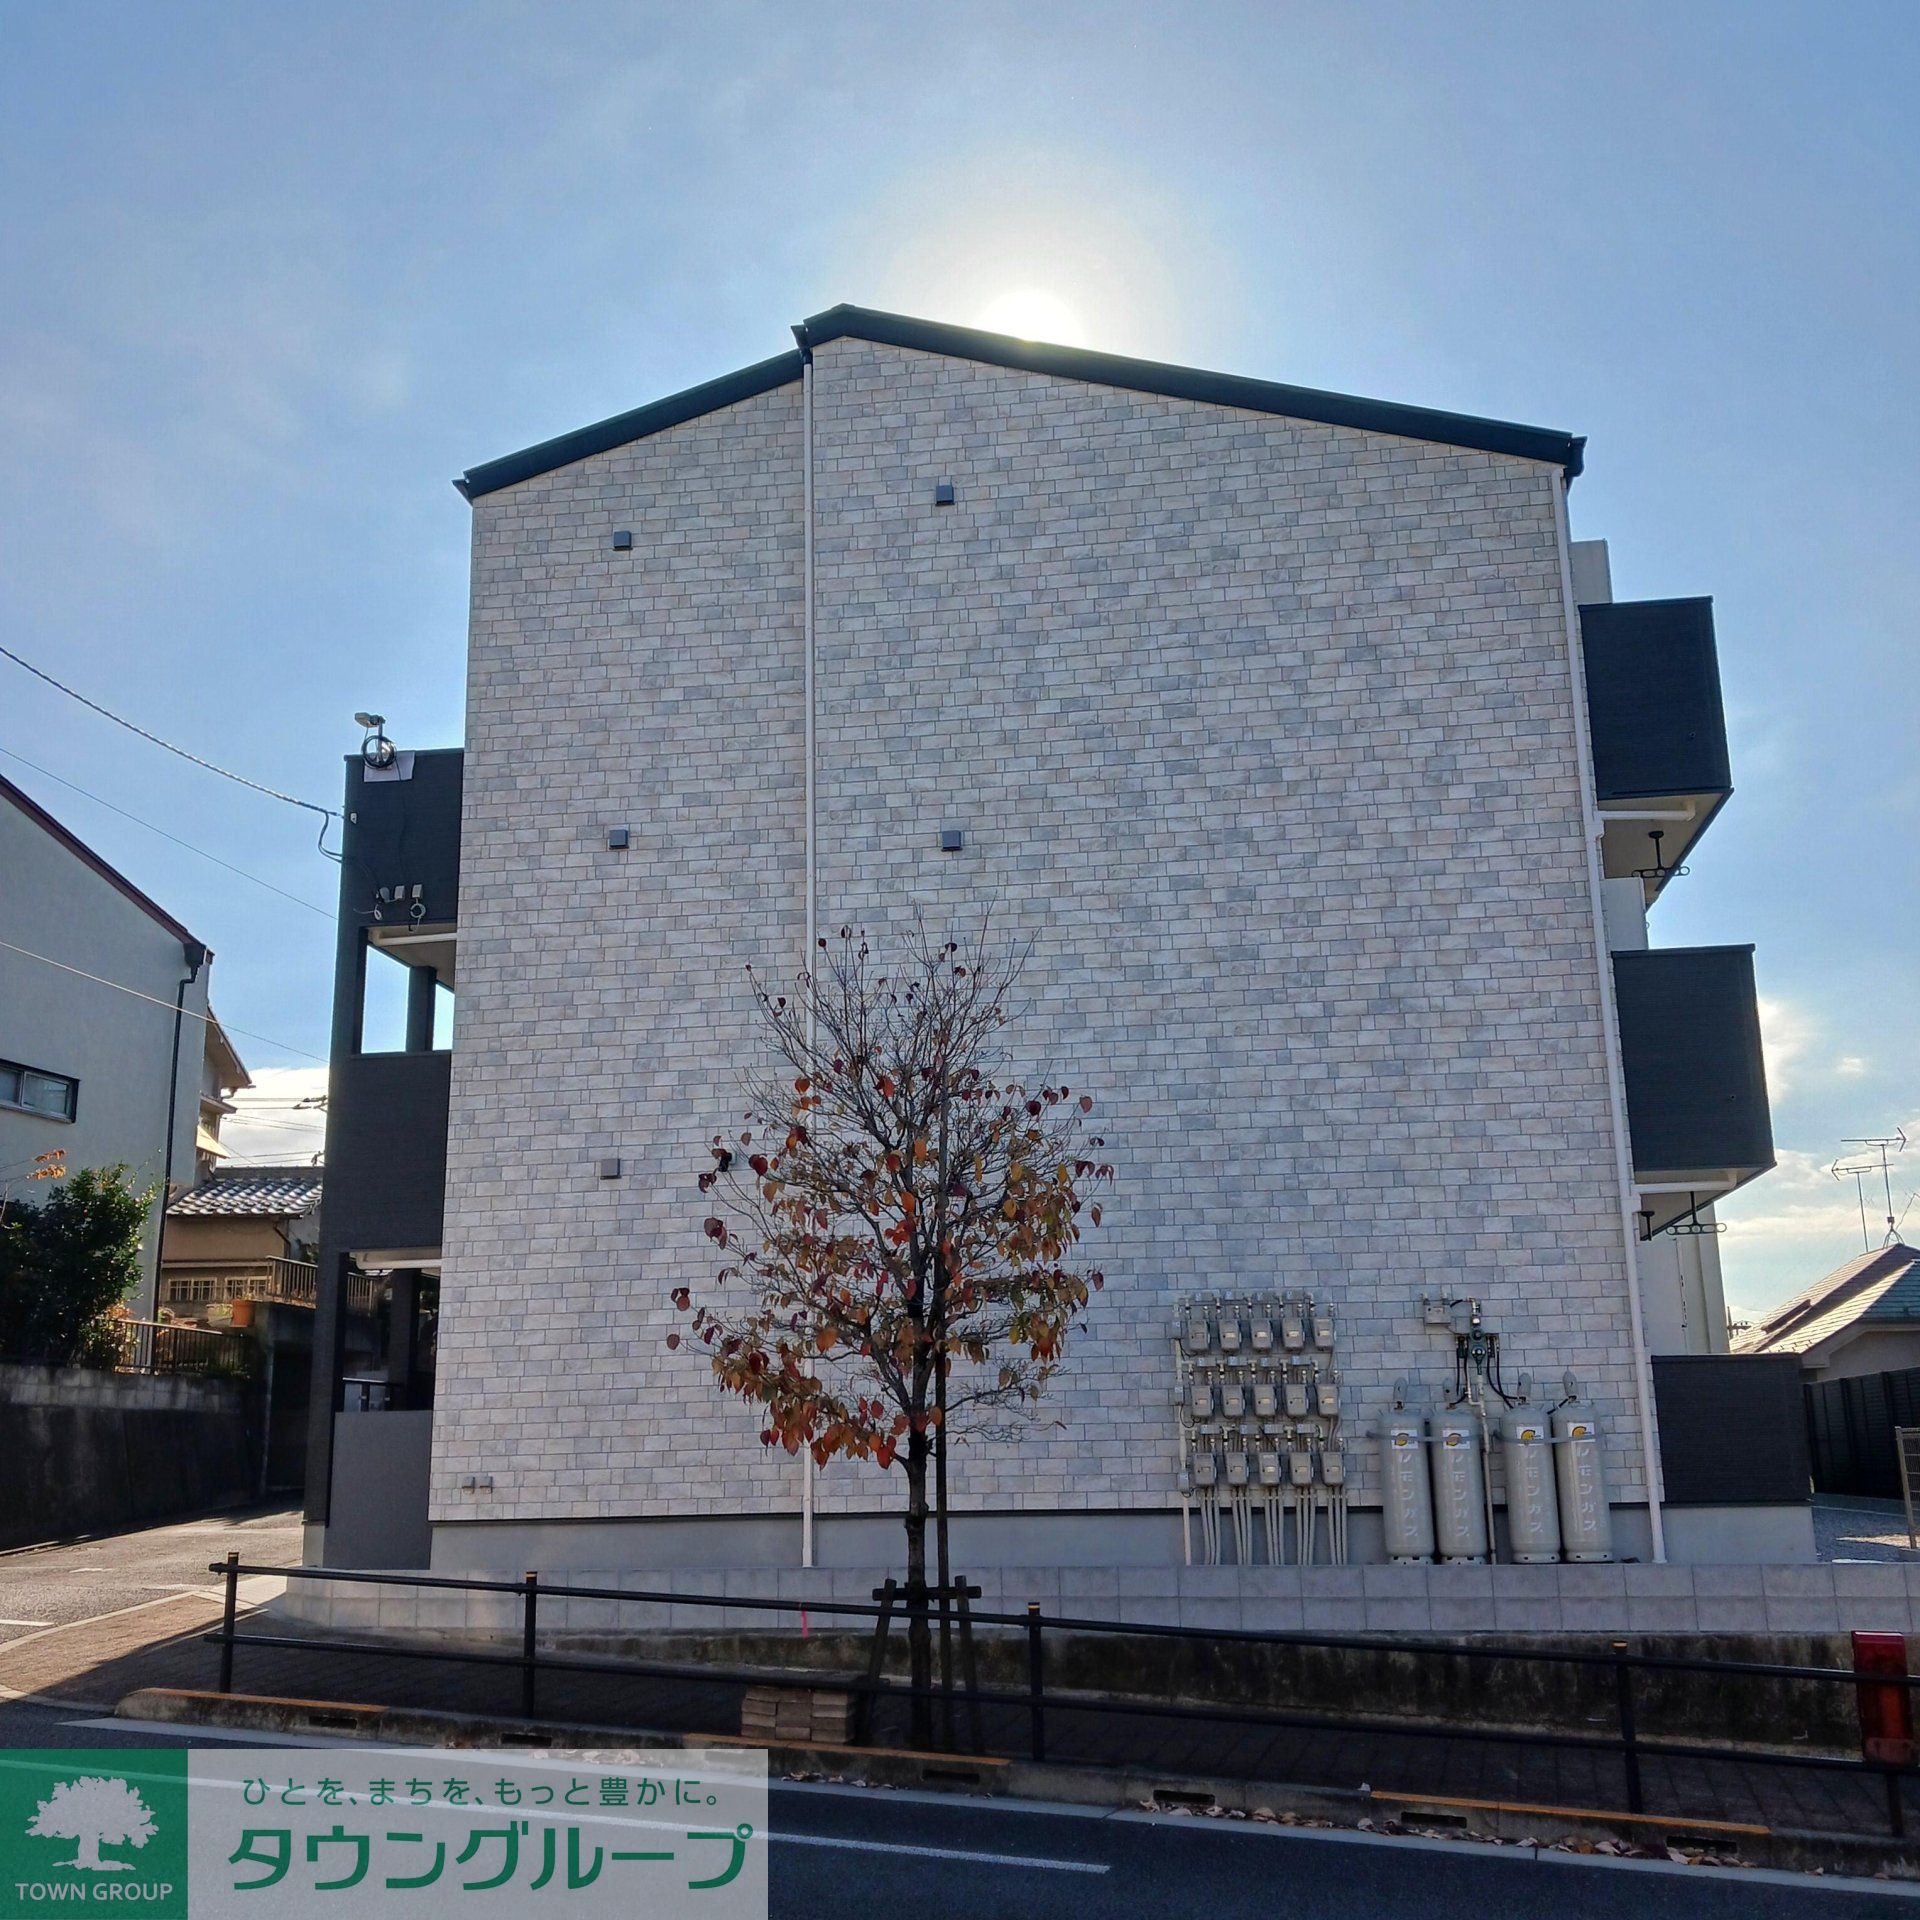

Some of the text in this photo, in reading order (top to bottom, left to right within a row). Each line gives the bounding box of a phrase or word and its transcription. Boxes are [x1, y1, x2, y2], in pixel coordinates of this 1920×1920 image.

[1399, 1453, 1419, 1537] レモンガス
[1452, 1453, 1471, 1537] レモンガス
[1525, 1450, 1544, 1533] レモンガス
[1577, 1447, 1598, 1532] レモンガス
